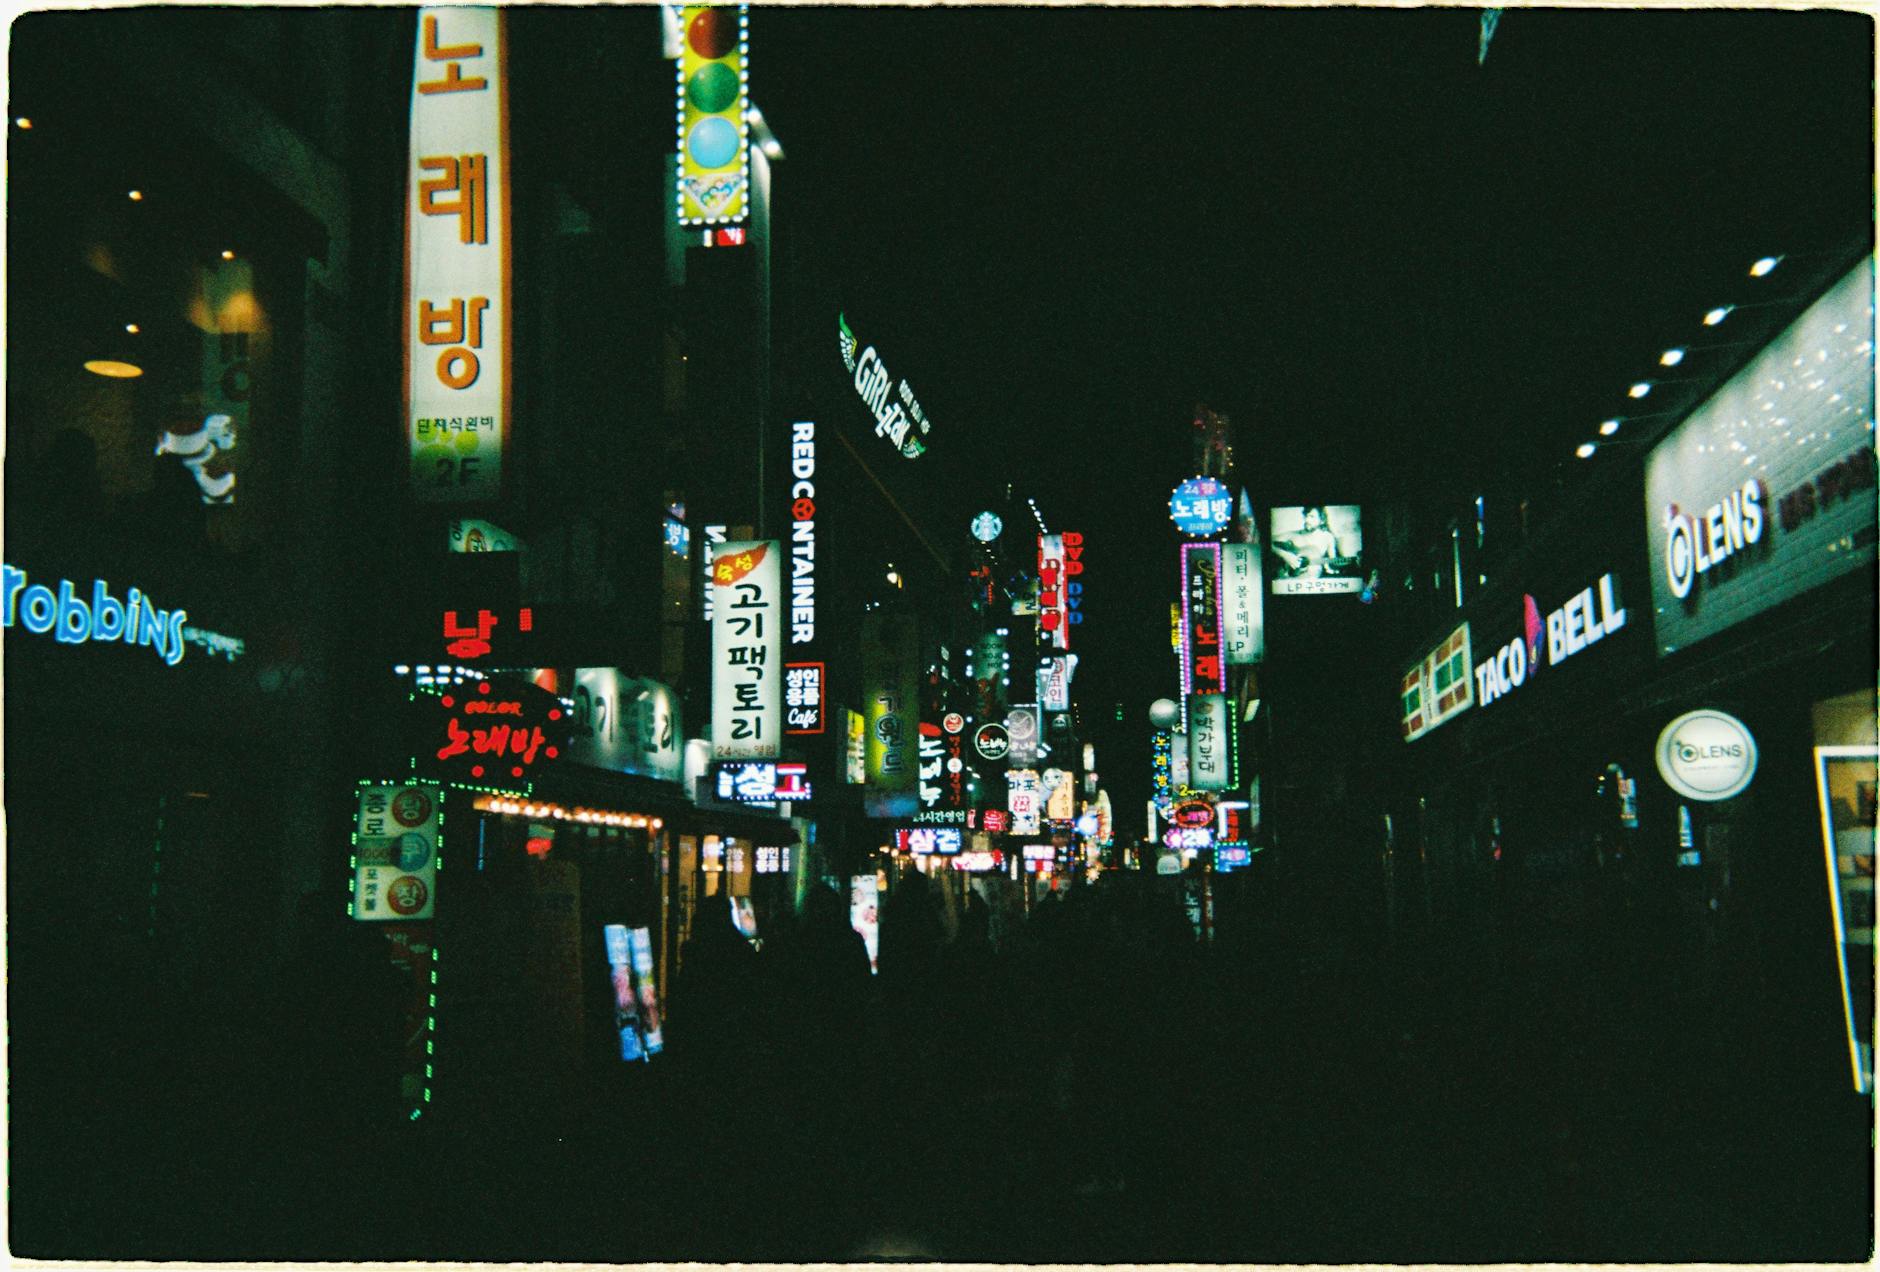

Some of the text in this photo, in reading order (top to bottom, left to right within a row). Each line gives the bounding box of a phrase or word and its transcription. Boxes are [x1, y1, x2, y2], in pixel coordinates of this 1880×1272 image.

[417, 14, 489, 391] 노래방
[436, 456, 481, 488] 2F
[1173, 498, 1228, 523] 노래방
[1065, 532, 1084, 575] DVD
[726, 584, 770, 740] 고기팩토리
[1228, 641, 1245, 653] LP
[1475, 637, 1527, 708] TACO
[1547, 574, 1627, 667] BELL
[787, 708, 819, 728] Café
[437, 718, 546, 764] 노래방
[1195, 717, 1216, 774] 박가부대
[1675, 741, 1742, 763] OLENS
